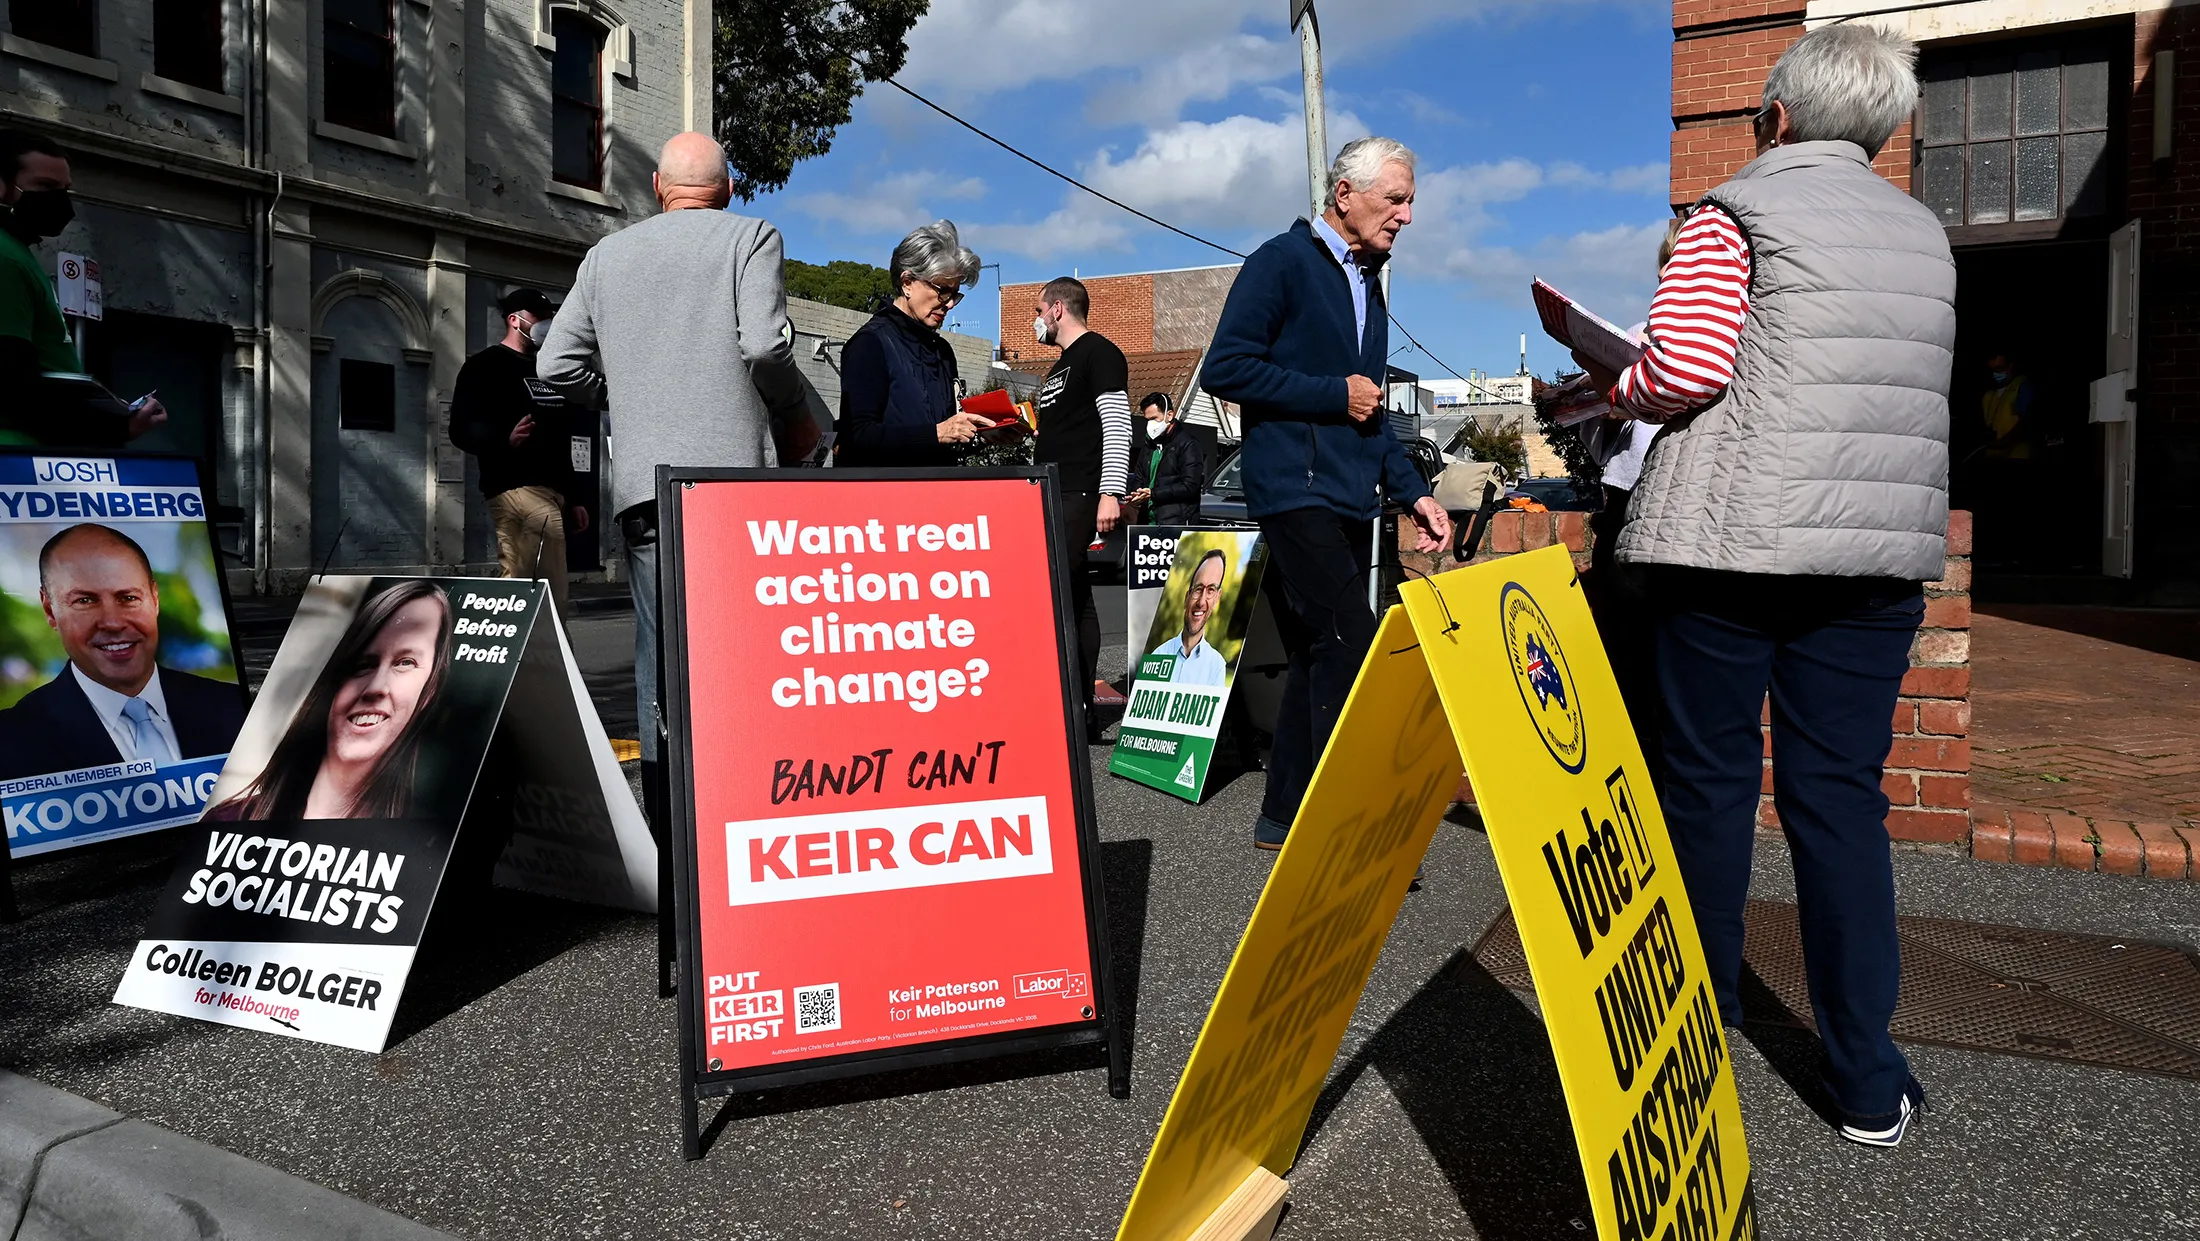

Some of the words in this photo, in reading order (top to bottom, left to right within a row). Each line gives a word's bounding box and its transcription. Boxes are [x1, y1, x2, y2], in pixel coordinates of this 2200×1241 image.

[39, 461, 114, 484] JOSH
[746, 519, 886, 556] Want
[896, 515, 991, 553] real
[462, 592, 527, 614] People
[755, 562, 920, 605] action
[929, 568, 991, 600] on
[454, 617, 518, 639] Before
[1508, 598, 1536, 622] AUSTRALIA
[780, 611, 976, 655] climate
[1508, 621, 1524, 676] UNITED
[1536, 616, 1560, 656] PARTY
[455, 643, 509, 664] Profit
[1142, 660, 1161, 675] VOTE
[771, 657, 990, 712] change?
[1129, 688, 1172, 720] ADAM
[1168, 692, 1220, 728] BANDT
[1120, 734, 1133, 747] FOR
[1133, 736, 1178, 756] MELBOURNE
[0, 776, 62, 795] FEDERAL
[64, 765, 122, 785] MEMBER
[127, 761, 153, 775] FOR
[770, 748, 893, 805] BANDT
[907, 740, 1006, 791] CAN'T
[3, 772, 220, 839] KOOYONG
[205, 832, 405, 893] VICTORIAN
[748, 827, 899, 883] KEIR
[909, 814, 1034, 866] CAN
[182, 871, 404, 935] SOCIALISTS
[1542, 806, 1630, 961] Vote
[146, 944, 252, 988] Colleen
[255, 961, 383, 1012] BOLGER
[709, 971, 760, 995] PUT
[889, 985, 922, 1004] Keir
[925, 979, 999, 1000] Paterson
[1019, 974, 1063, 995] Labor
[1594, 895, 1685, 1092] UNITED
[194, 988, 218, 1007] for
[218, 991, 300, 1021] Melbourne
[715, 996, 779, 1020] KE1R
[889, 1005, 912, 1022] for
[915, 995, 1006, 1019] Melbourne
[711, 1020, 784, 1045] FIRST
[1608, 978, 1724, 1241] AUSTRALIA
[1662, 1108, 1729, 1241] ARTY
